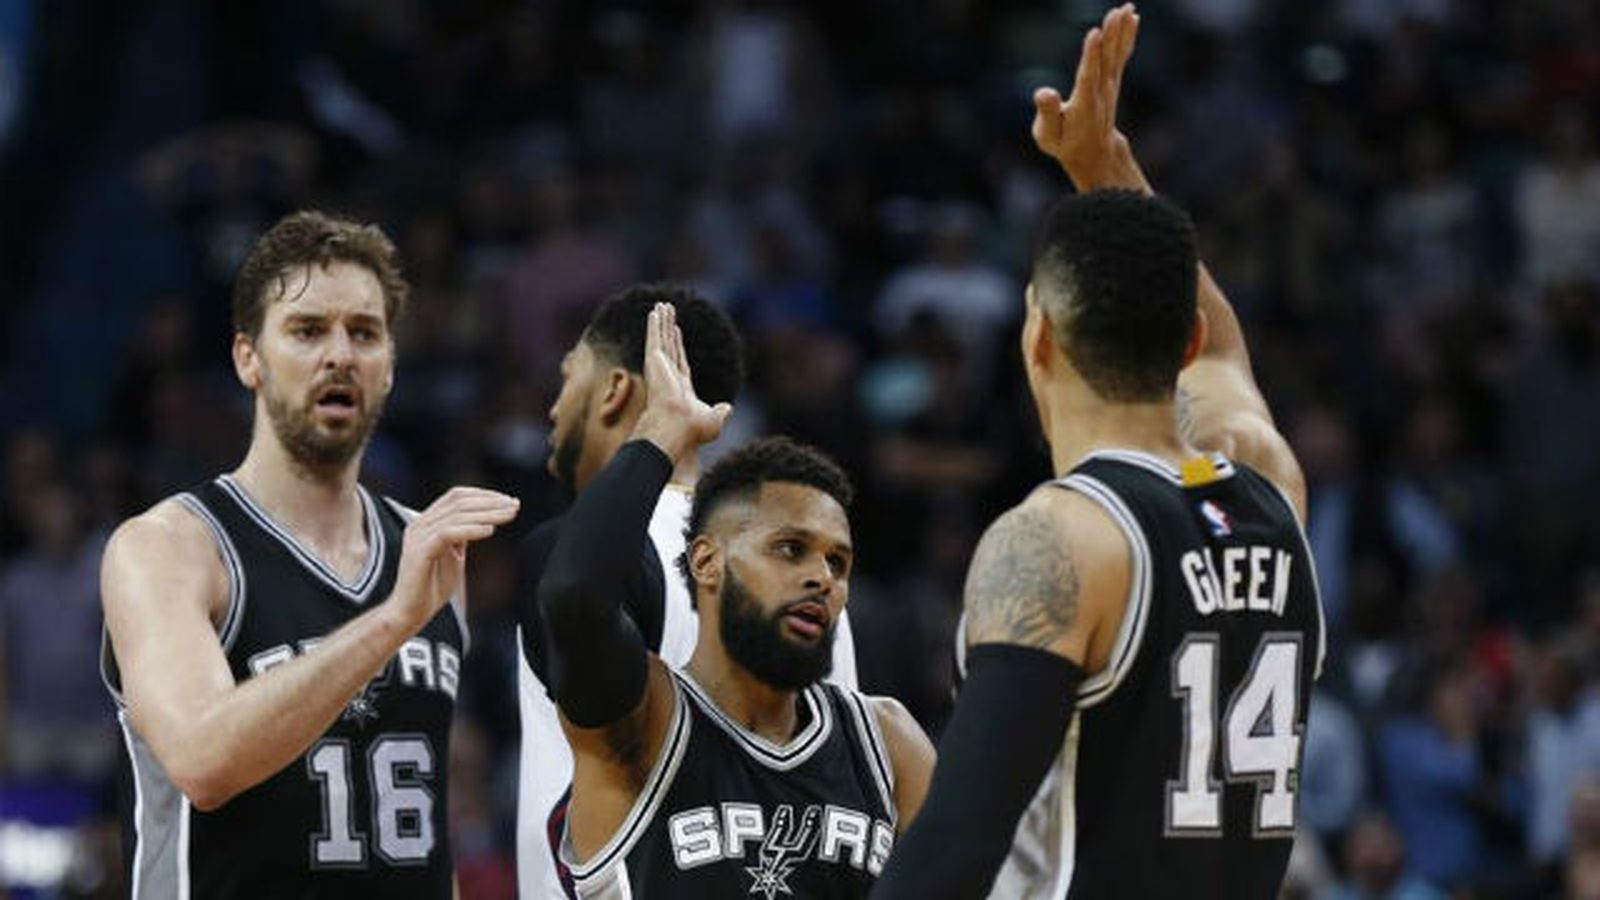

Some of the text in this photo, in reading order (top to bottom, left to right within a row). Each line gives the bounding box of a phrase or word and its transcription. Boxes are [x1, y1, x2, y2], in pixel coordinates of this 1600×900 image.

[307, 733, 436, 869] 16
[1164, 631, 1304, 838] 14
[668, 801, 895, 899] SPURS
